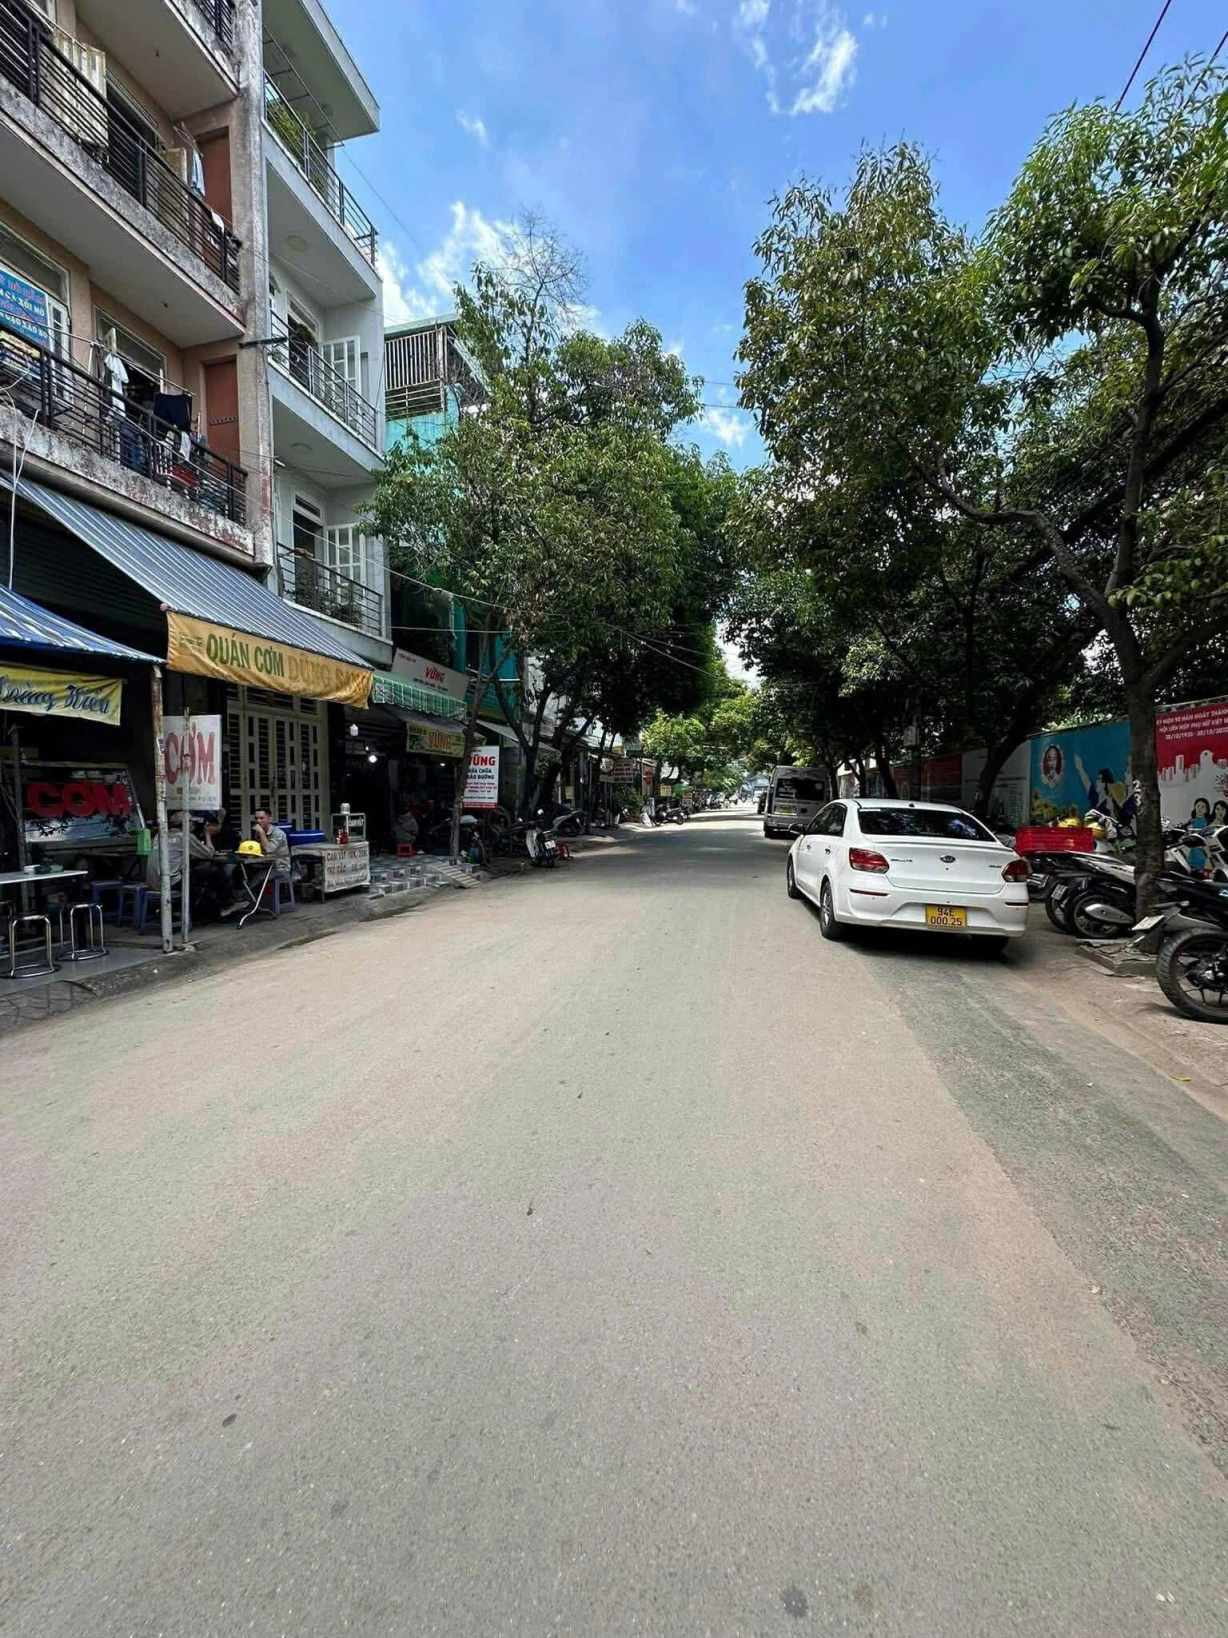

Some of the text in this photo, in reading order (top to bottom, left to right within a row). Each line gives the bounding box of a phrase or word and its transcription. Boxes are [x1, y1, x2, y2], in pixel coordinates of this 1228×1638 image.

[206, 633, 250, 670] QUÁN
[254, 645, 285, 678] CƠM
[26, 777, 132, 819] CƠM
[930, 916, 963, 927] 000.25
[937, 907, 955, 917] 94E
